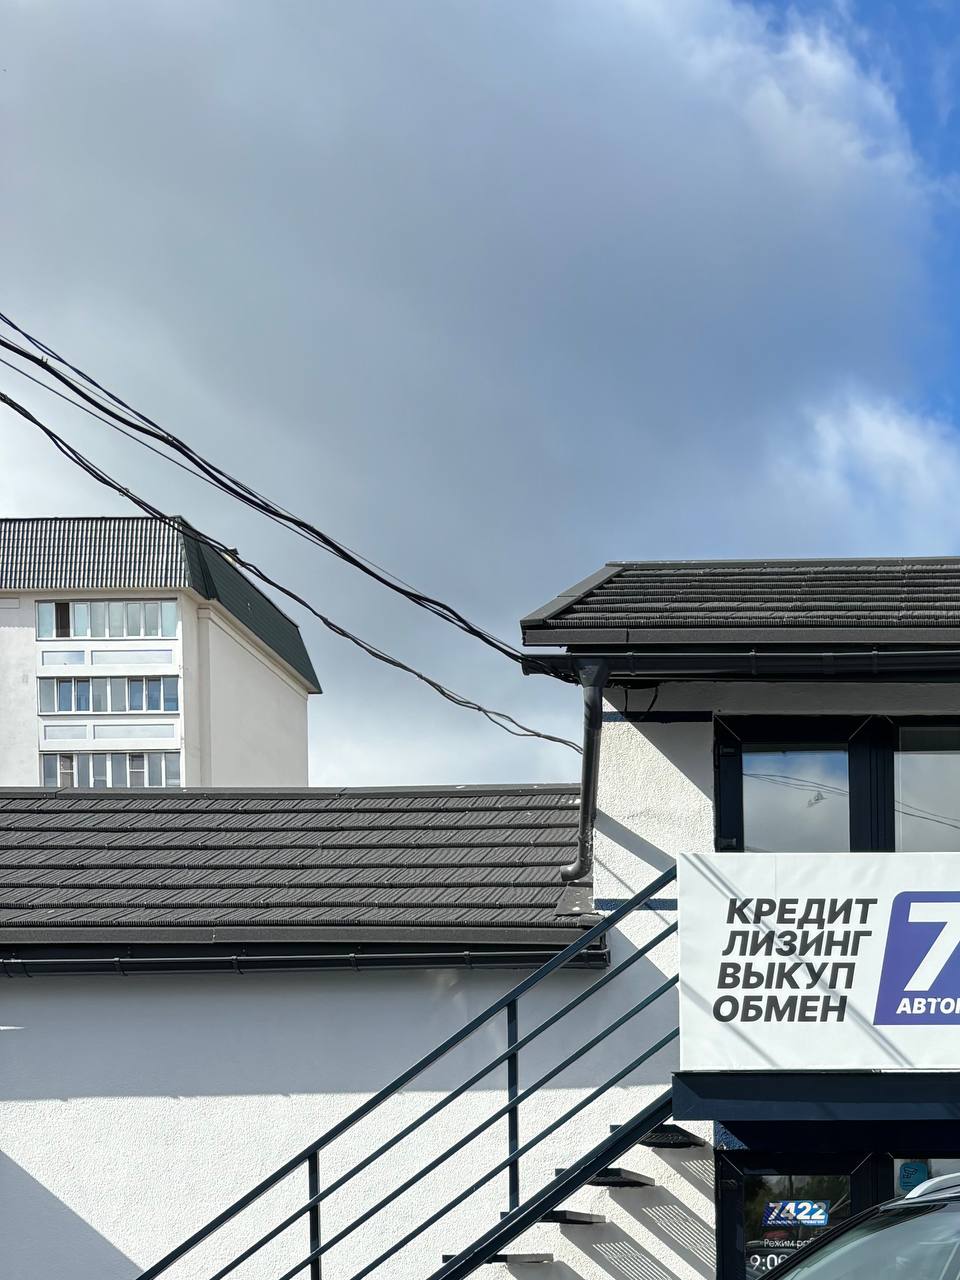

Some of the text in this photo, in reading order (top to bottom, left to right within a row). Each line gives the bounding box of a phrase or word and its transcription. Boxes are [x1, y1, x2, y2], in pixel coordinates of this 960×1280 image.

[726, 897, 877, 926] КРЕДИТ
[721, 929, 872, 957] ЛИЗИНГ
[716, 962, 856, 989] ВЫКУП
[711, 994, 848, 1022] ОБМЕН
[768, 1201, 827, 1221] 7422
